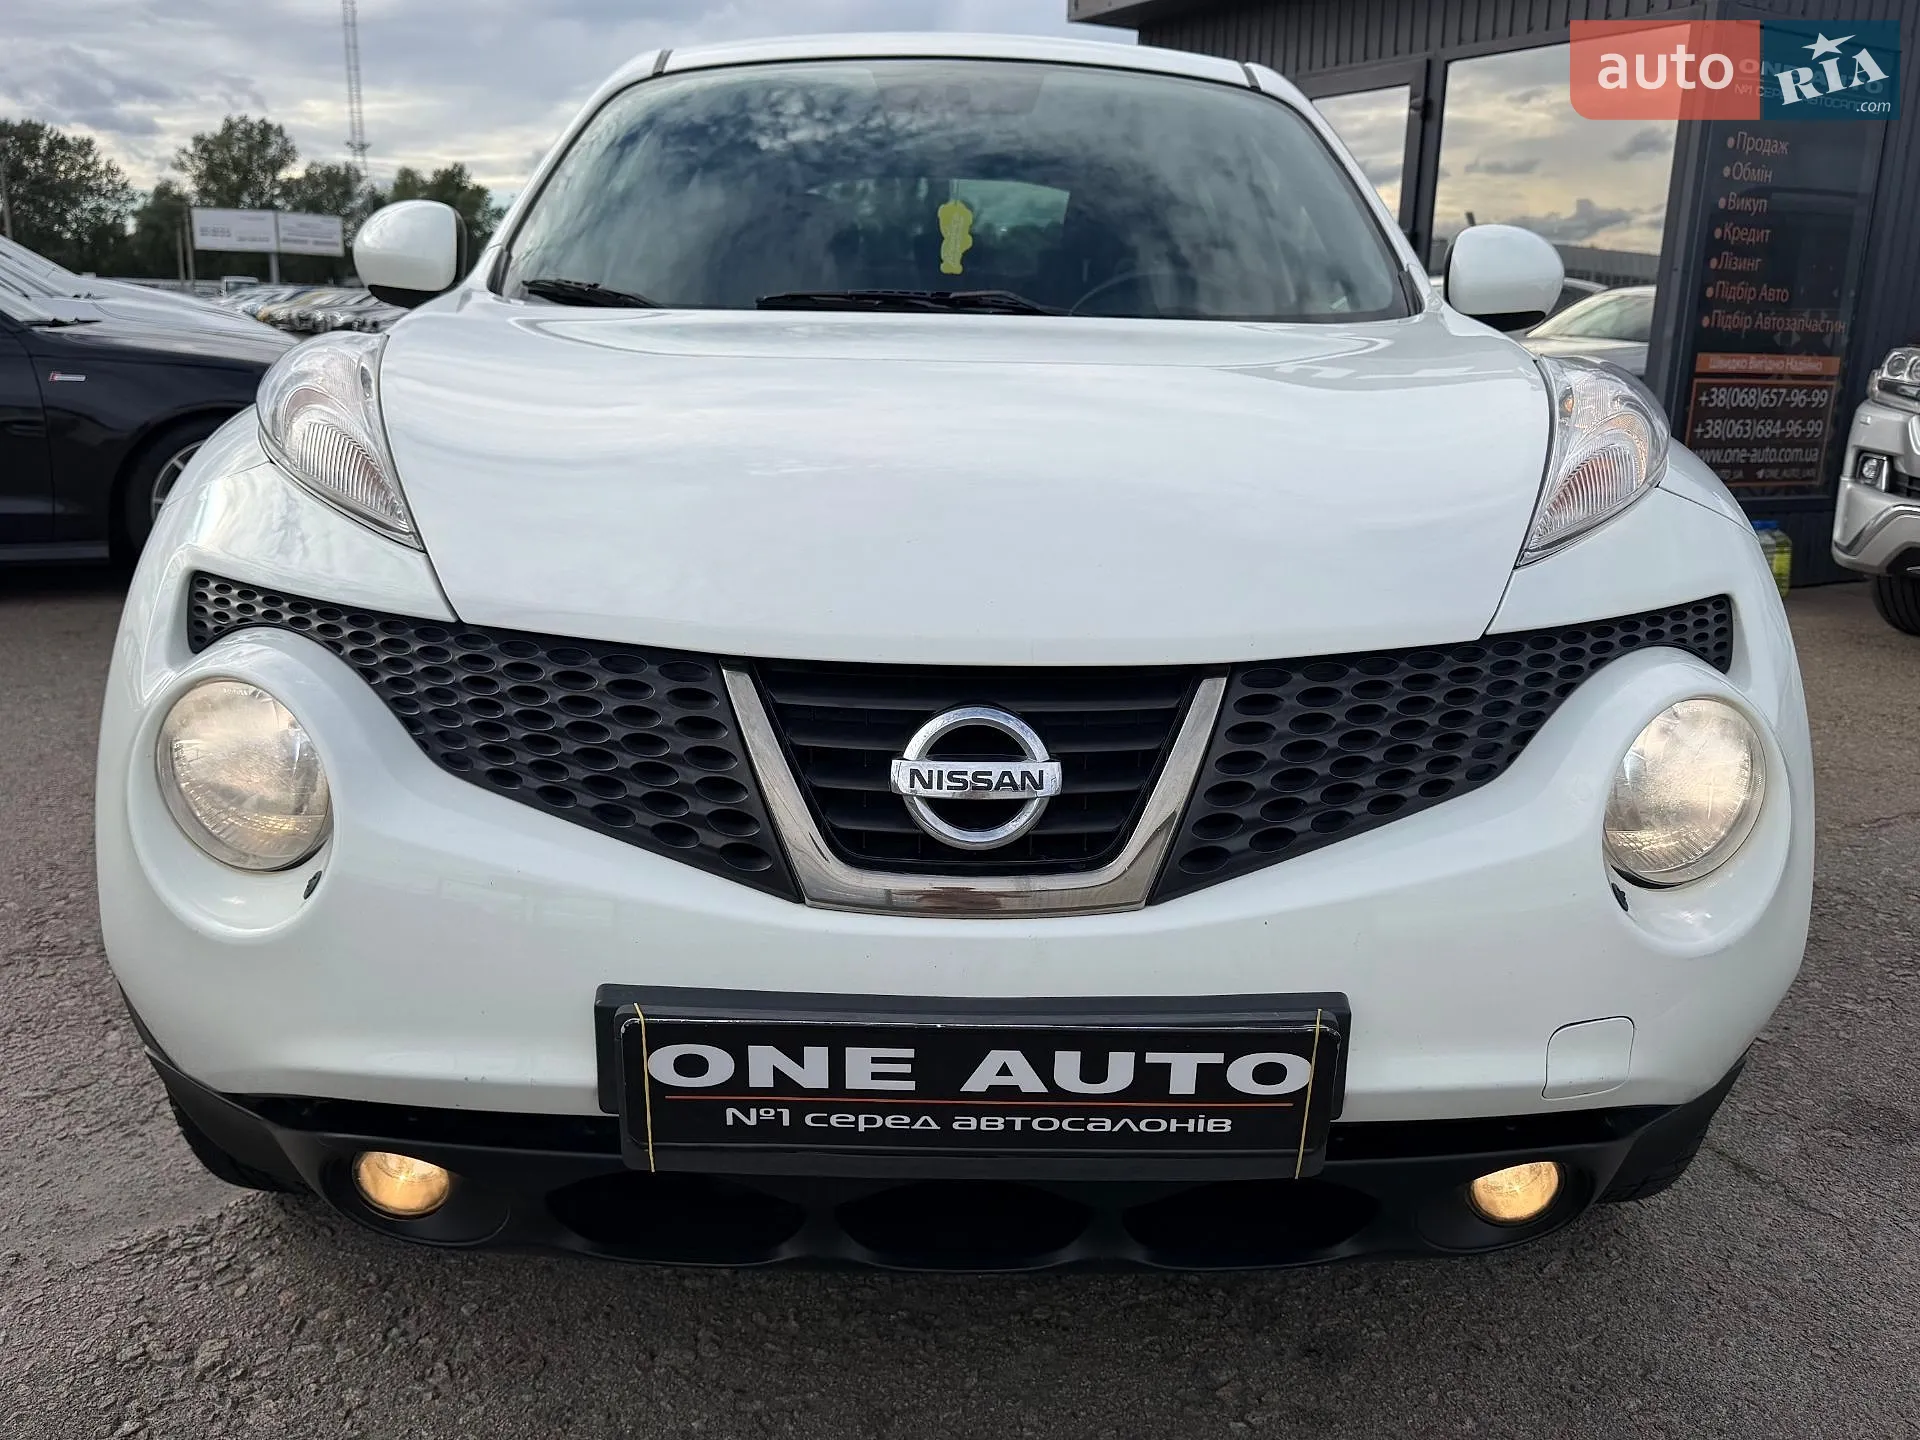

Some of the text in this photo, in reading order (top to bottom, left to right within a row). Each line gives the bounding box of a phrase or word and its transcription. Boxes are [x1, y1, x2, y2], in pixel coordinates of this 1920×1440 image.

[1736, 131, 1789, 156] Продаж
[1732, 161, 1773, 183] Обмін
[1727, 191, 1768, 216] Викуп
[1723, 222, 1771, 246] Кредит
[1718, 251, 1762, 272] Лізинг
[1714, 280, 1790, 304] Підбір Авто
[1710, 309, 1753, 333] Підбір
[1697, 386, 1829, 410] +38(068)657-96-99
[1693, 417, 1824, 441] +38(063)684-96-99
[909, 768, 1044, 791] NISSAN
[648, 1044, 1312, 1095] ONE AUTO
[804, 1113, 941, 1132] серед
[952, 1114, 1232, 1133] автосалонів
